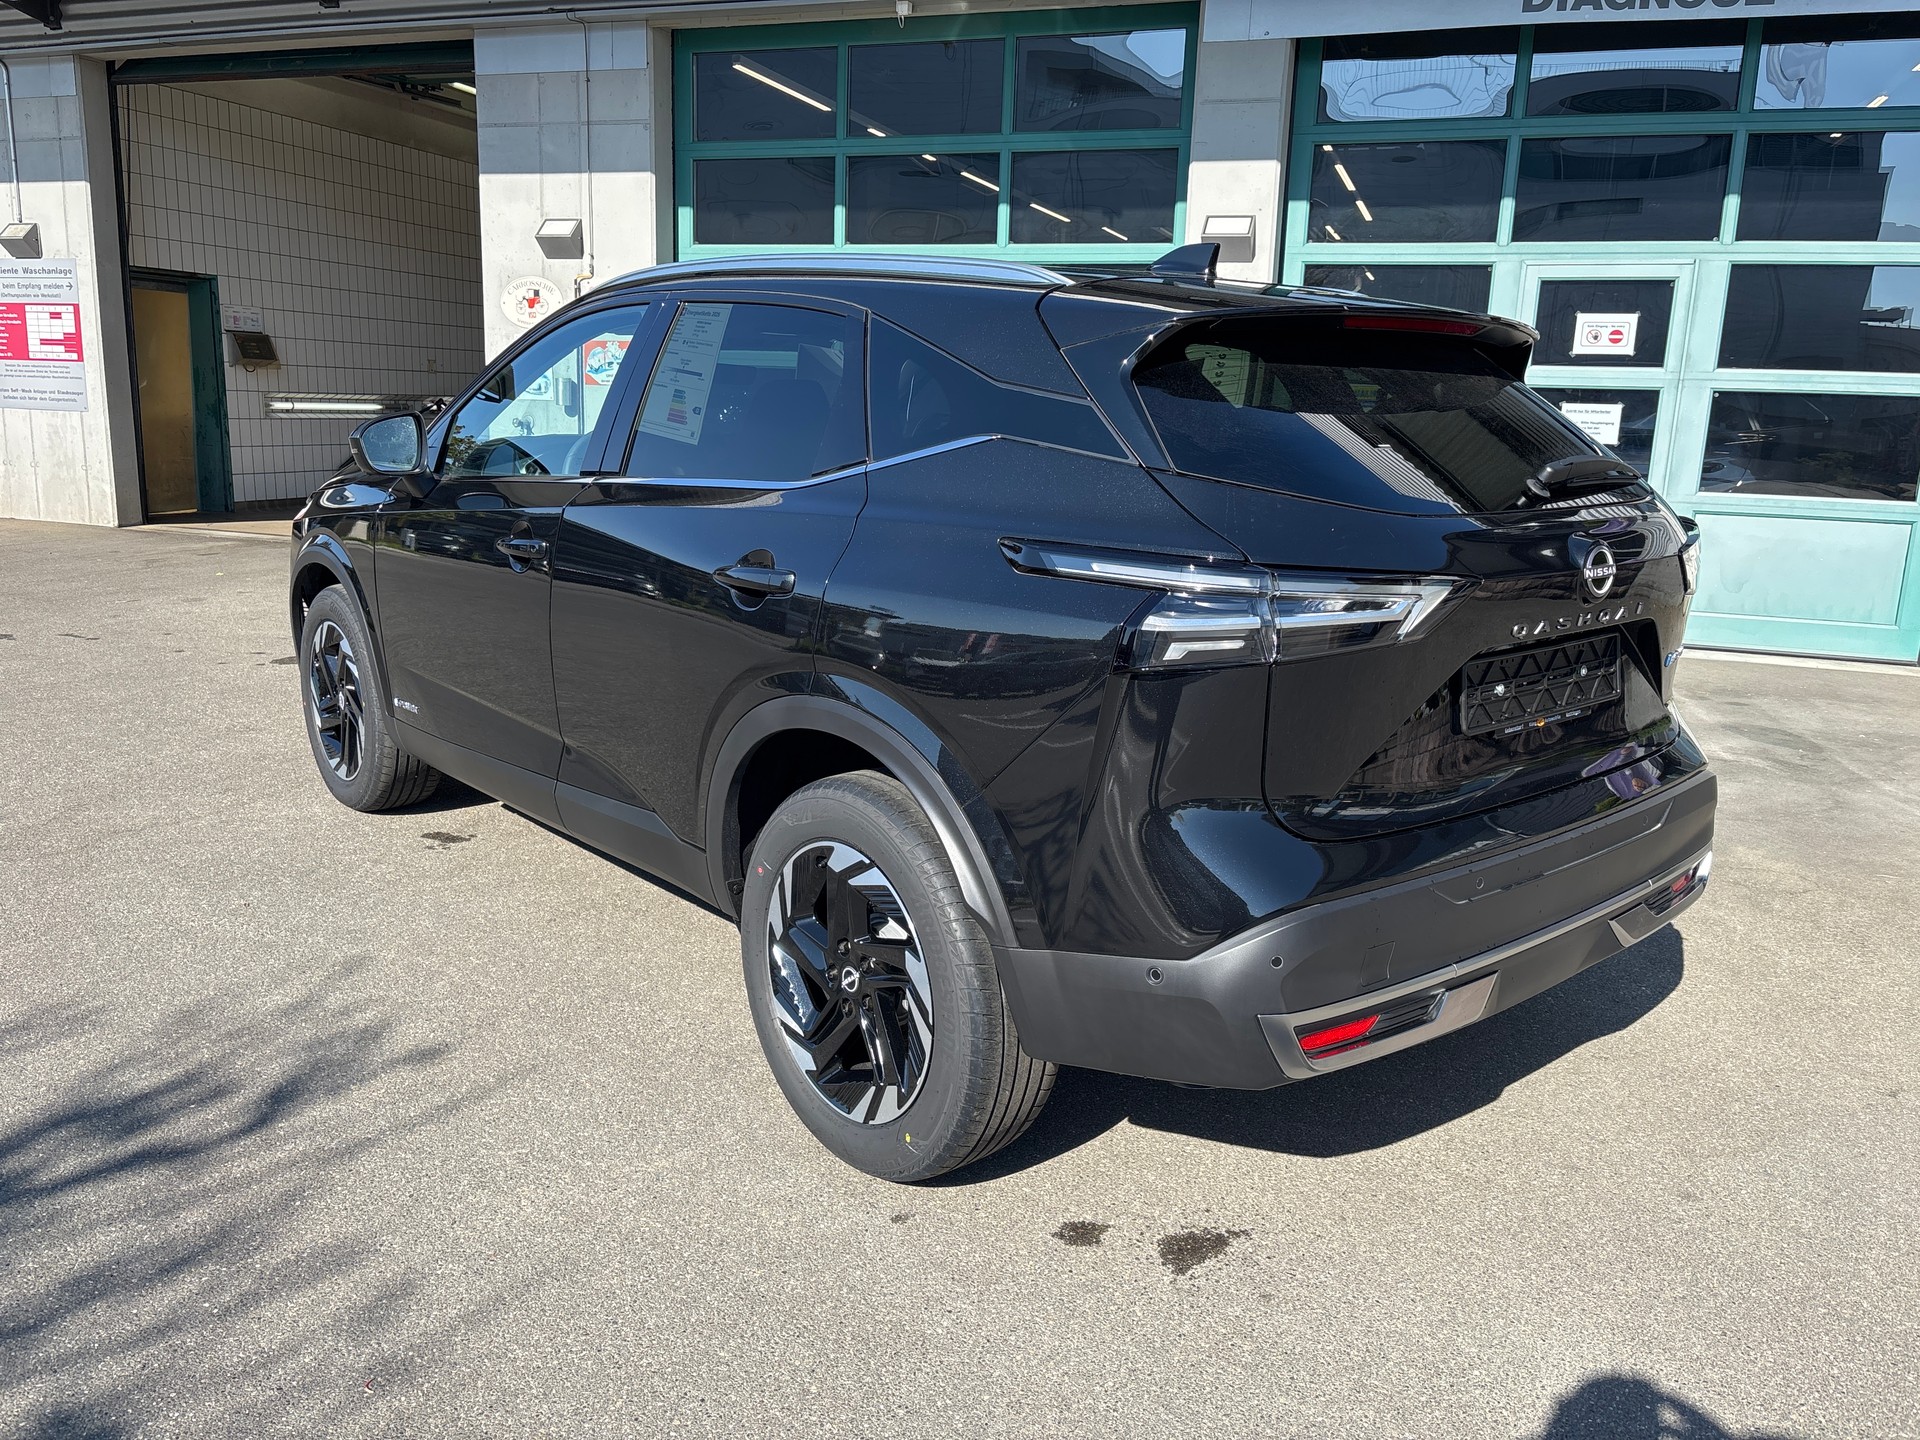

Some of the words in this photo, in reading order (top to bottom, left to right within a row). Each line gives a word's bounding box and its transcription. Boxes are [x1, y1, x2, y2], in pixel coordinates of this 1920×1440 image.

[0, 267, 18, 275] iente
[21, 266, 73, 276] Waschanlage
[507, 280, 556, 295] CARROSSERIE
[1585, 564, 1616, 578] NISSAN
[1511, 602, 1644, 639] QASHQAI
